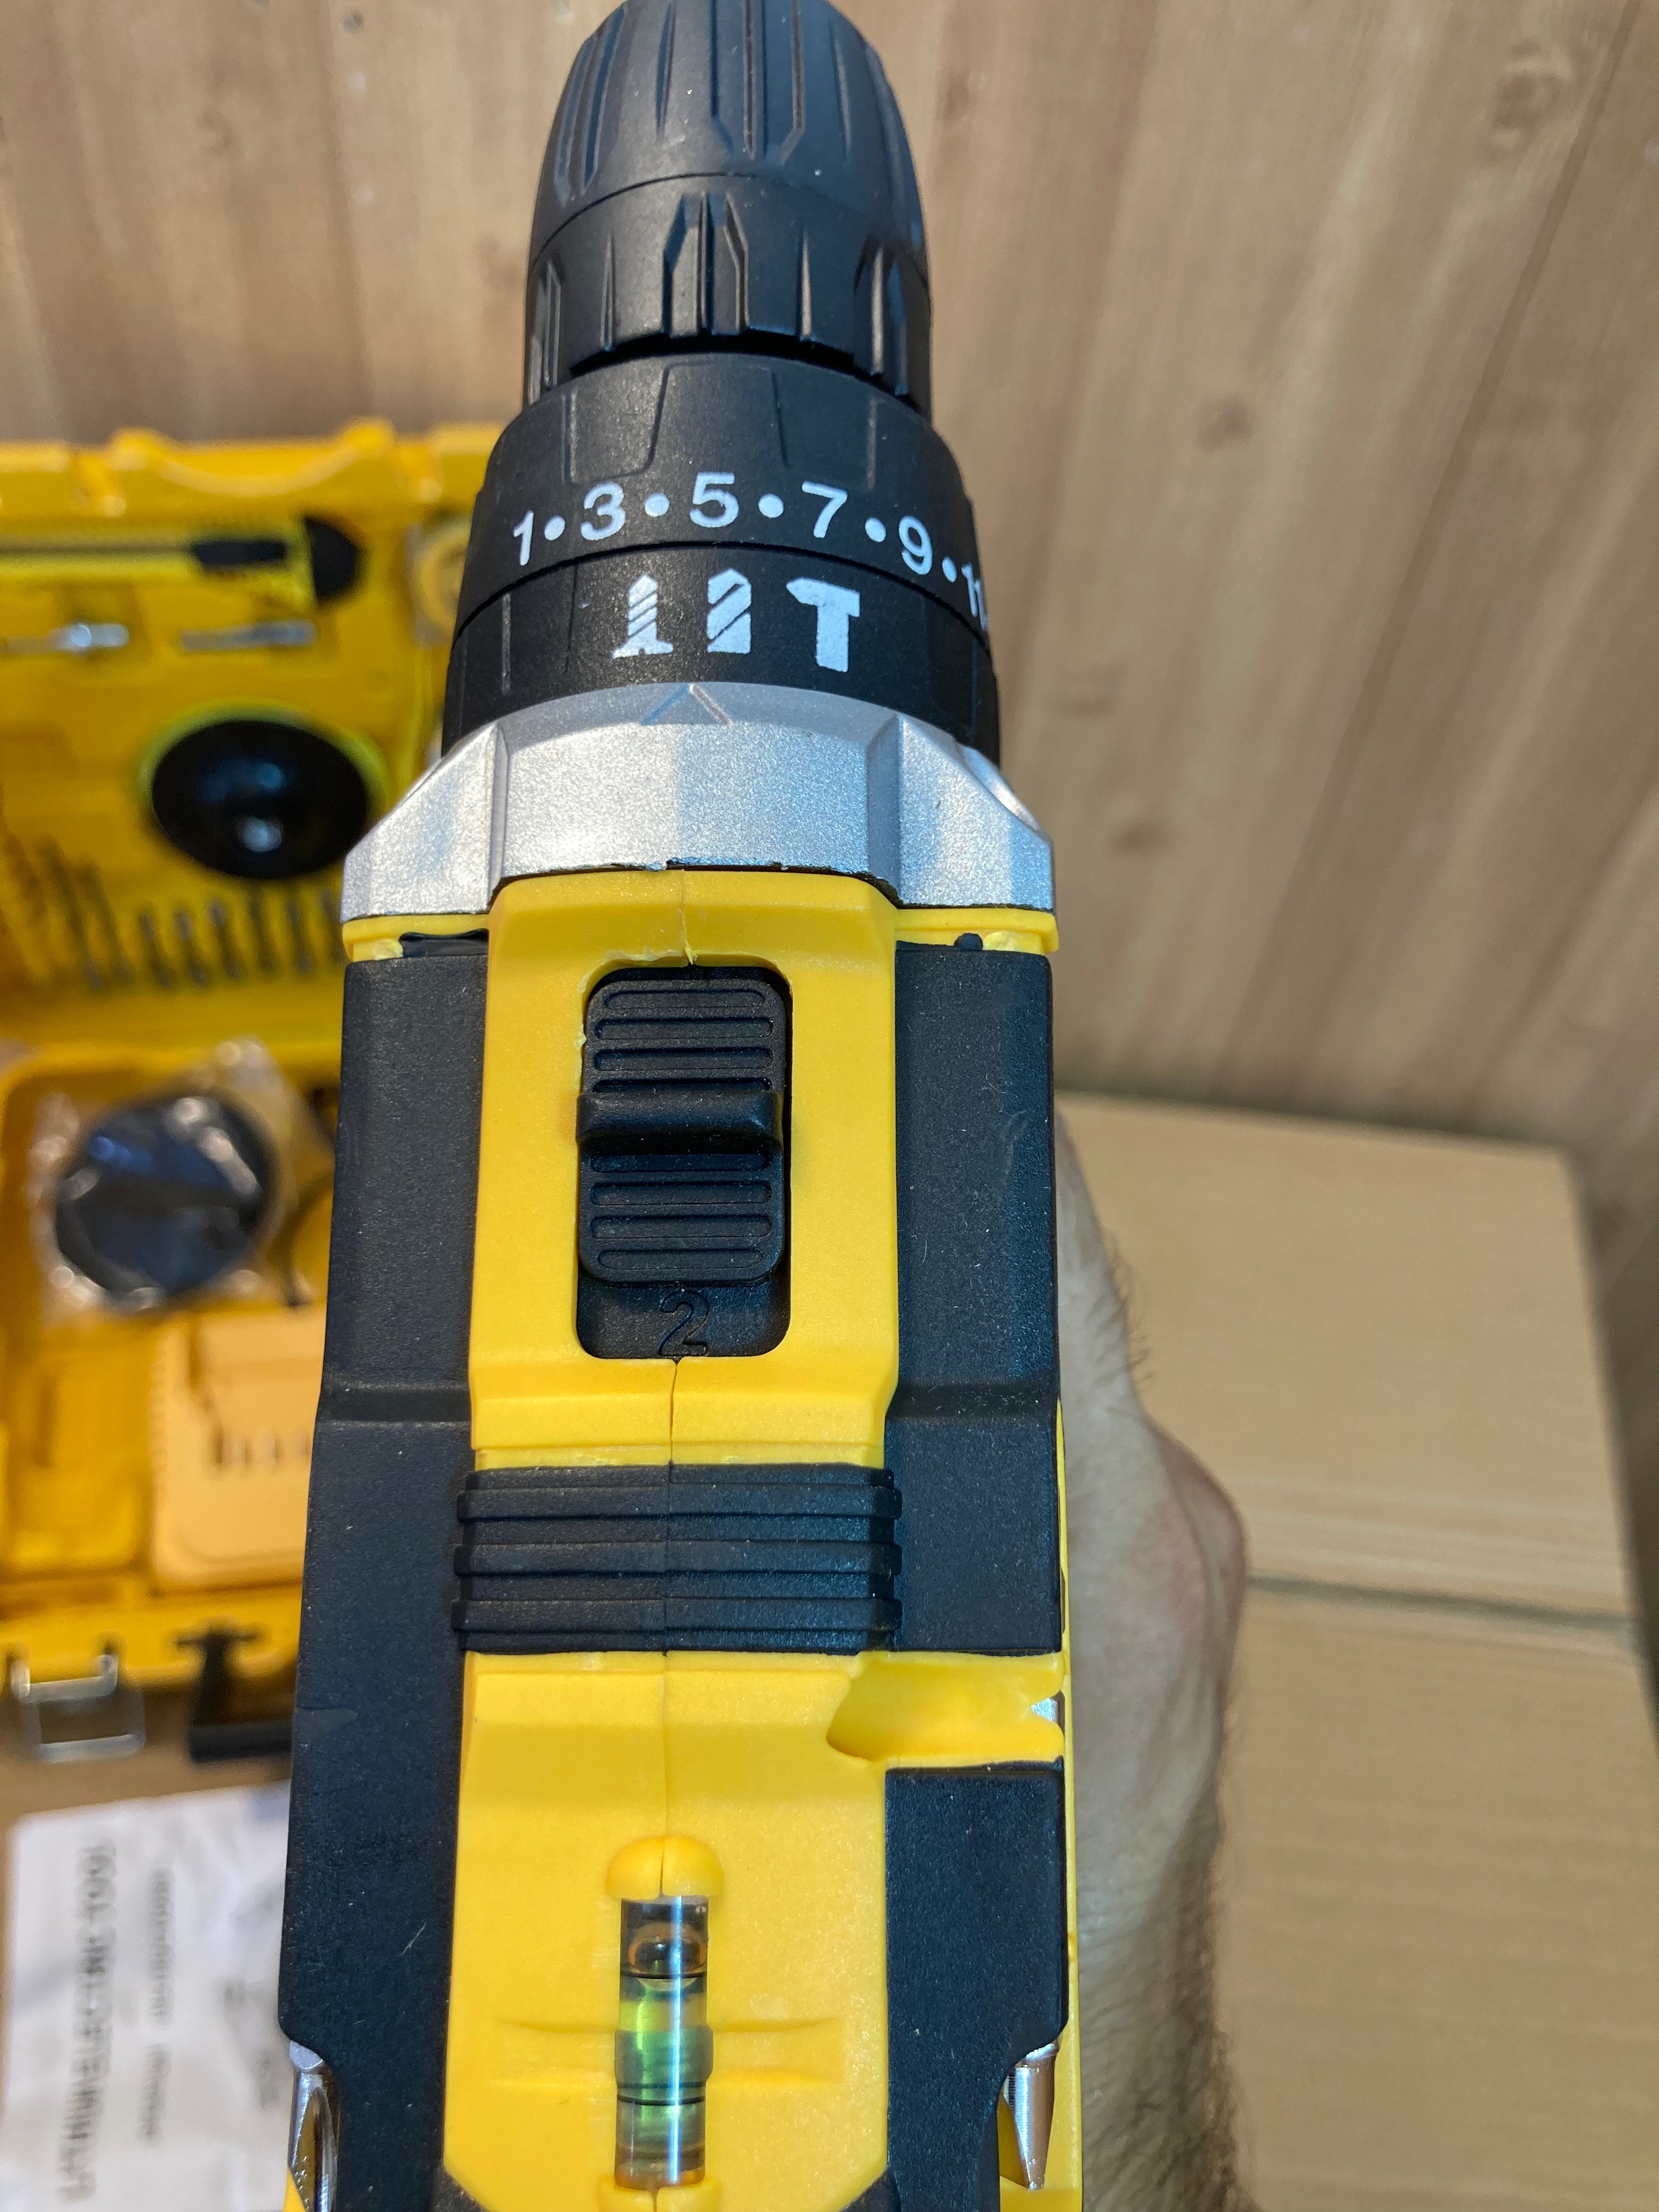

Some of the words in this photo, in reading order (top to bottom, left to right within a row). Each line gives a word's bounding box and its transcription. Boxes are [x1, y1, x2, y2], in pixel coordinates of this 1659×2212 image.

[513, 510, 534, 566] 1
[580, 481, 626, 541] 3
[689, 472, 740, 528] 5
[802, 481, 848, 538] 7
[898, 515, 933, 575] 9
[658, 1289, 709, 1357] 2
